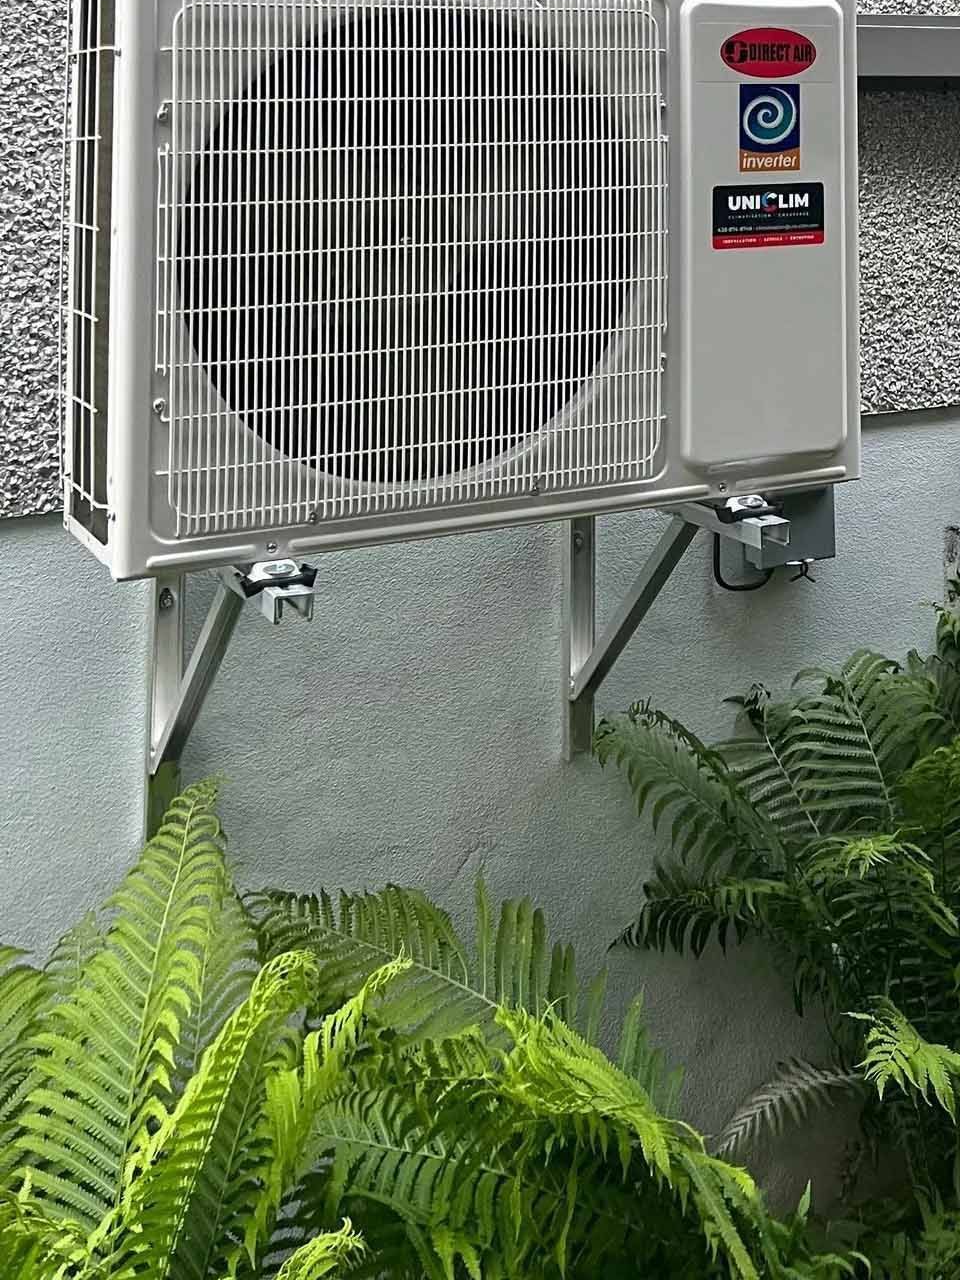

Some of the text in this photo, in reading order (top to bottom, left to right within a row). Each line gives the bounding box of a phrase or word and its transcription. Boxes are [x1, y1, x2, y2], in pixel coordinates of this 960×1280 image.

[748, 43, 812, 62] DIRECT AIR
[742, 152, 797, 169] inverter
[727, 191, 809, 213] UNICLIM
